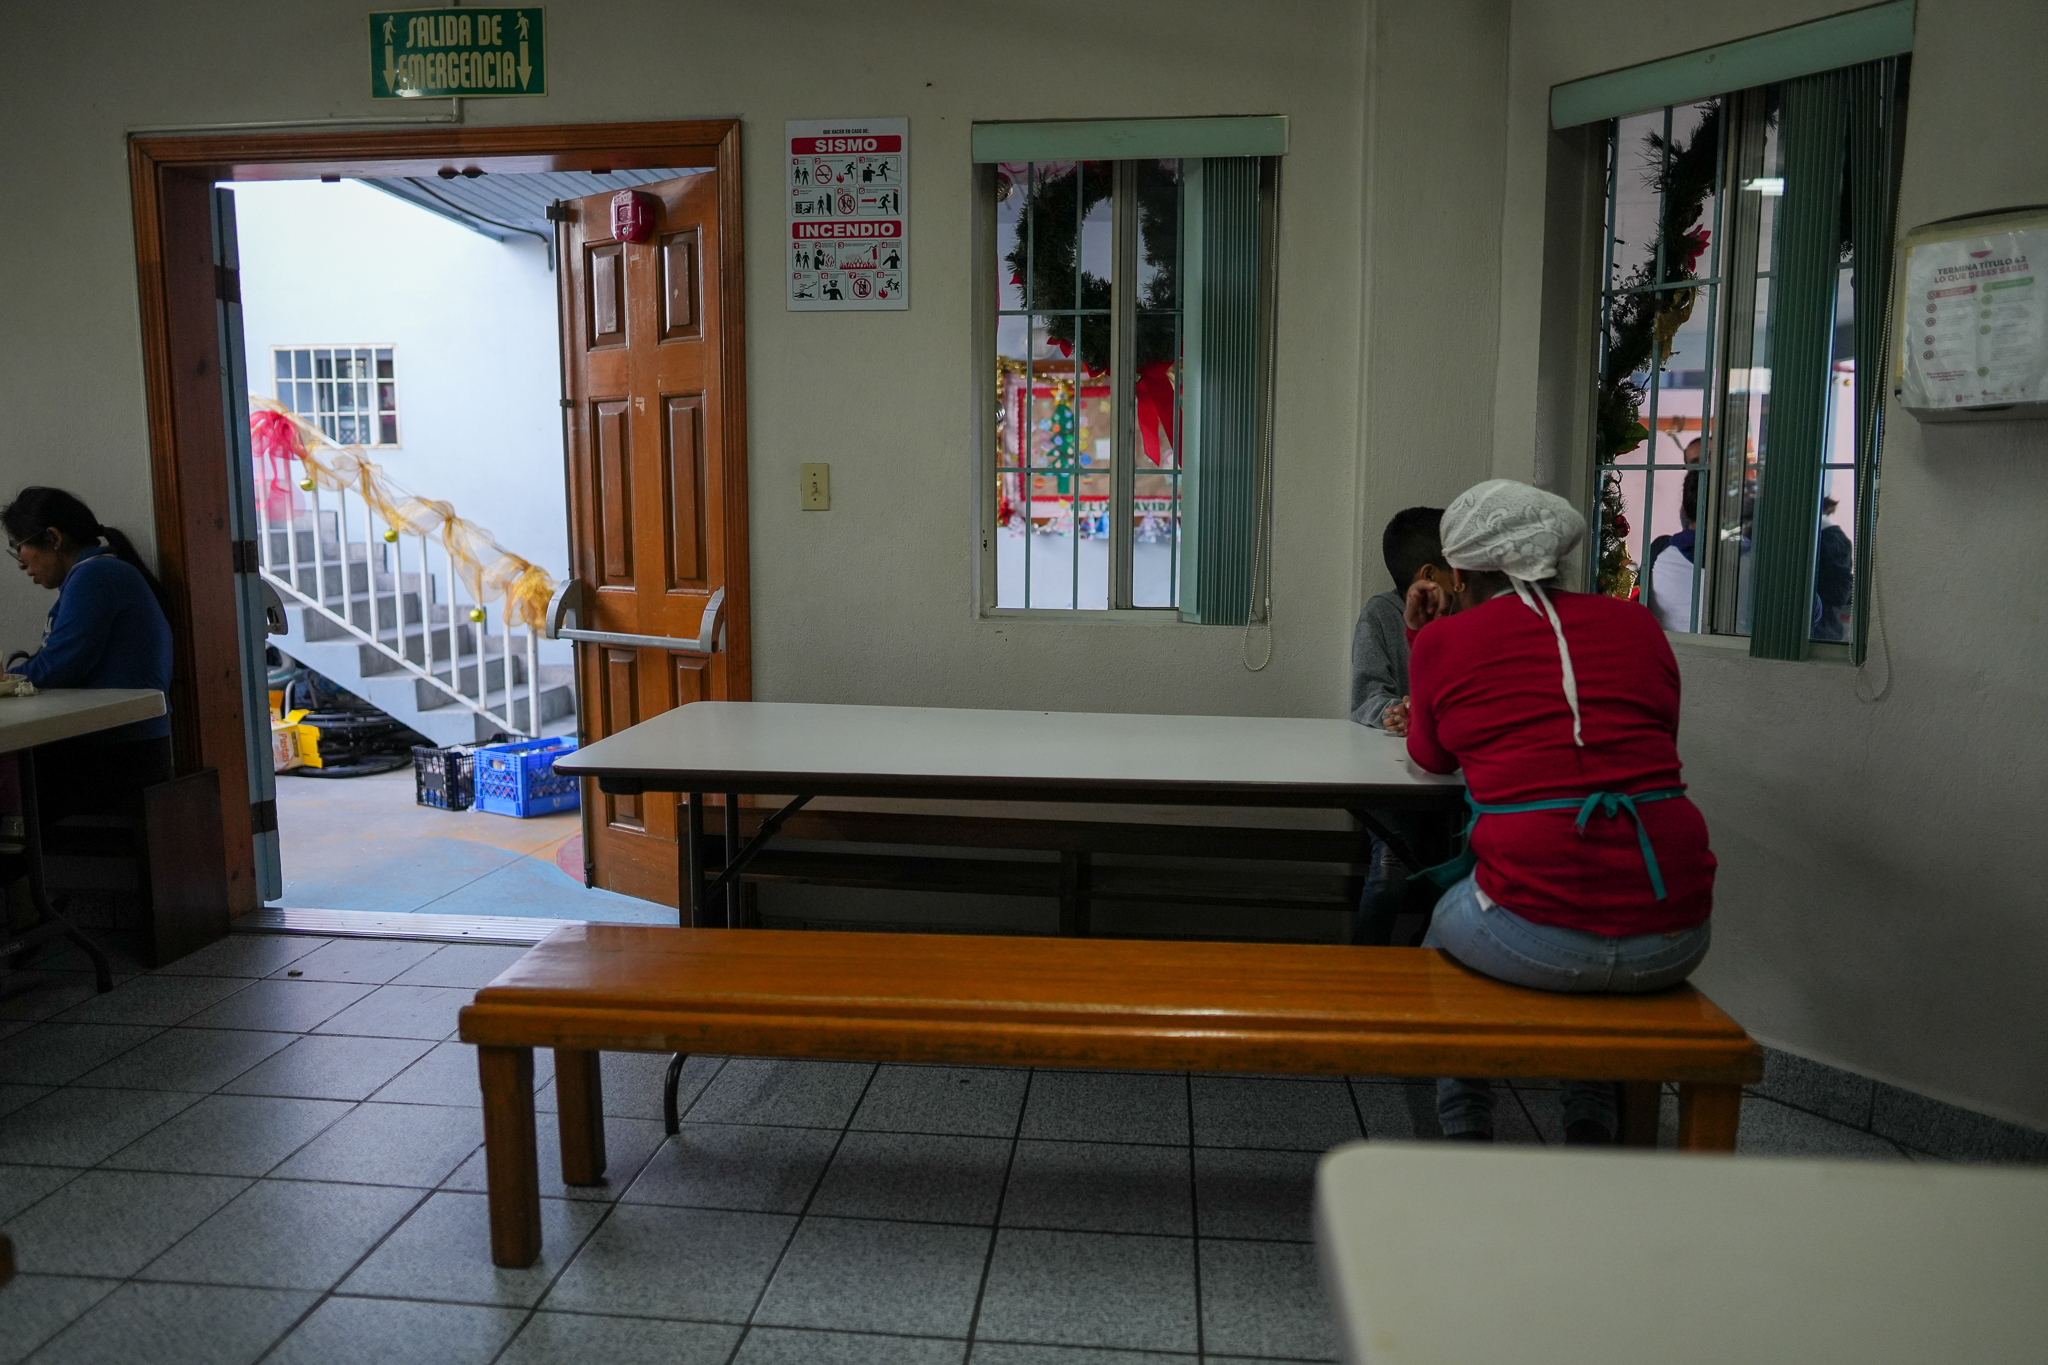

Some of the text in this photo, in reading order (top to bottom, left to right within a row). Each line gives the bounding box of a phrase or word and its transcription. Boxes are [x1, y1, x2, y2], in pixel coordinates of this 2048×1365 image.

[406, 14, 502, 48] SALIDA DE
[398, 51, 516, 89] EMERGENCIA
[815, 138, 878, 153] SISMO
[799, 223, 894, 238] INCENDIO
[1937, 264, 1978, 275] TERMINA
[1948, 271, 1967, 281] QUE
[1968, 268, 1997, 279] DEBES
[1999, 263, 2029, 274] SABER
